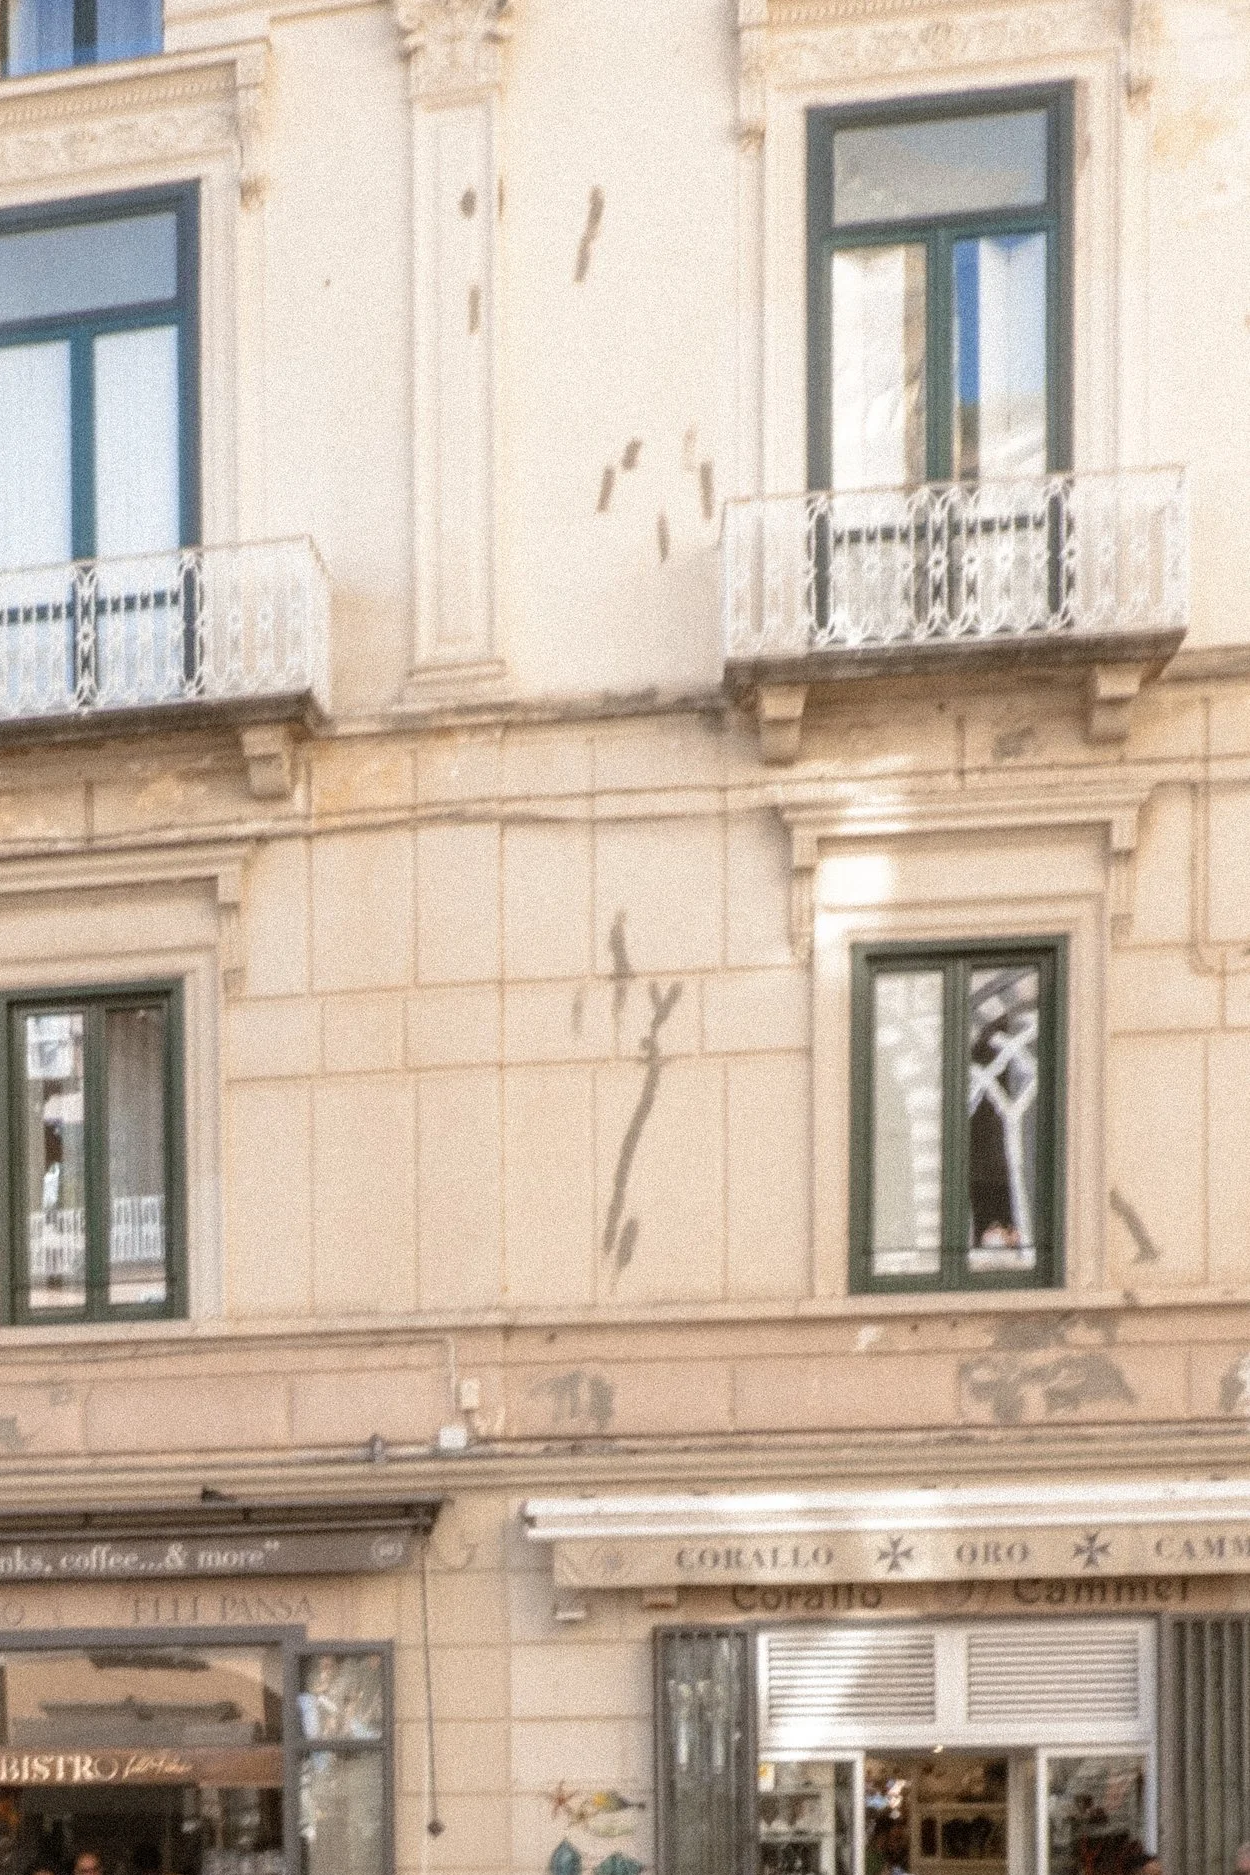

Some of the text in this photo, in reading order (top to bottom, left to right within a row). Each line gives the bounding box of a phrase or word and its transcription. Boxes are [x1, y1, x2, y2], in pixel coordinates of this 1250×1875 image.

[676, 1546, 836, 1571] CORALLO
[955, 1541, 1030, 1564] ORO
[731, 1582, 882, 1612] Corallo
[0, 1754, 119, 1783] BISTRO
